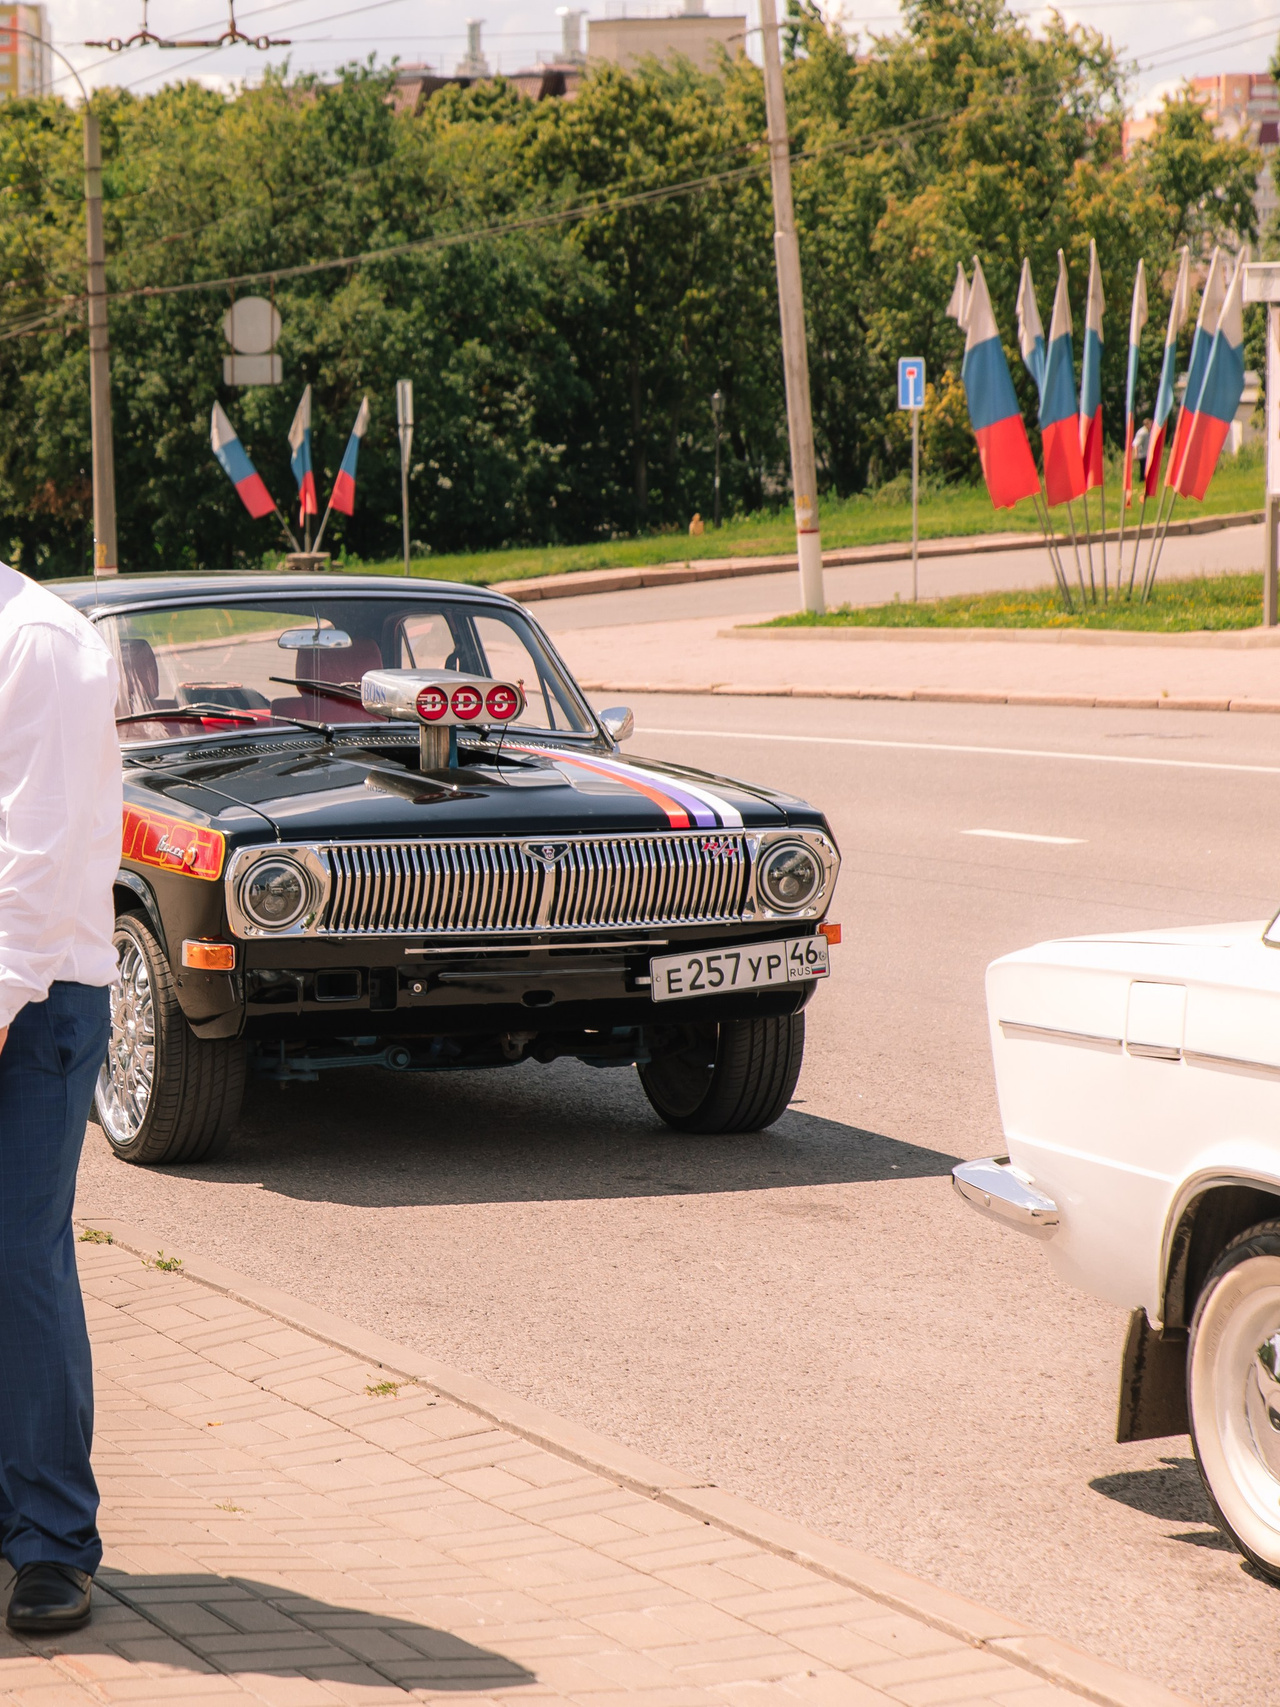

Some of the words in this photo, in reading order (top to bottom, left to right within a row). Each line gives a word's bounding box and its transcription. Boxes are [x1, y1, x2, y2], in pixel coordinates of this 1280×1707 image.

[364, 682, 386, 704] BOSS
[701, 841, 738, 859] R/T
[790, 941, 818, 966] 46
[790, 967, 810, 977] RUS
